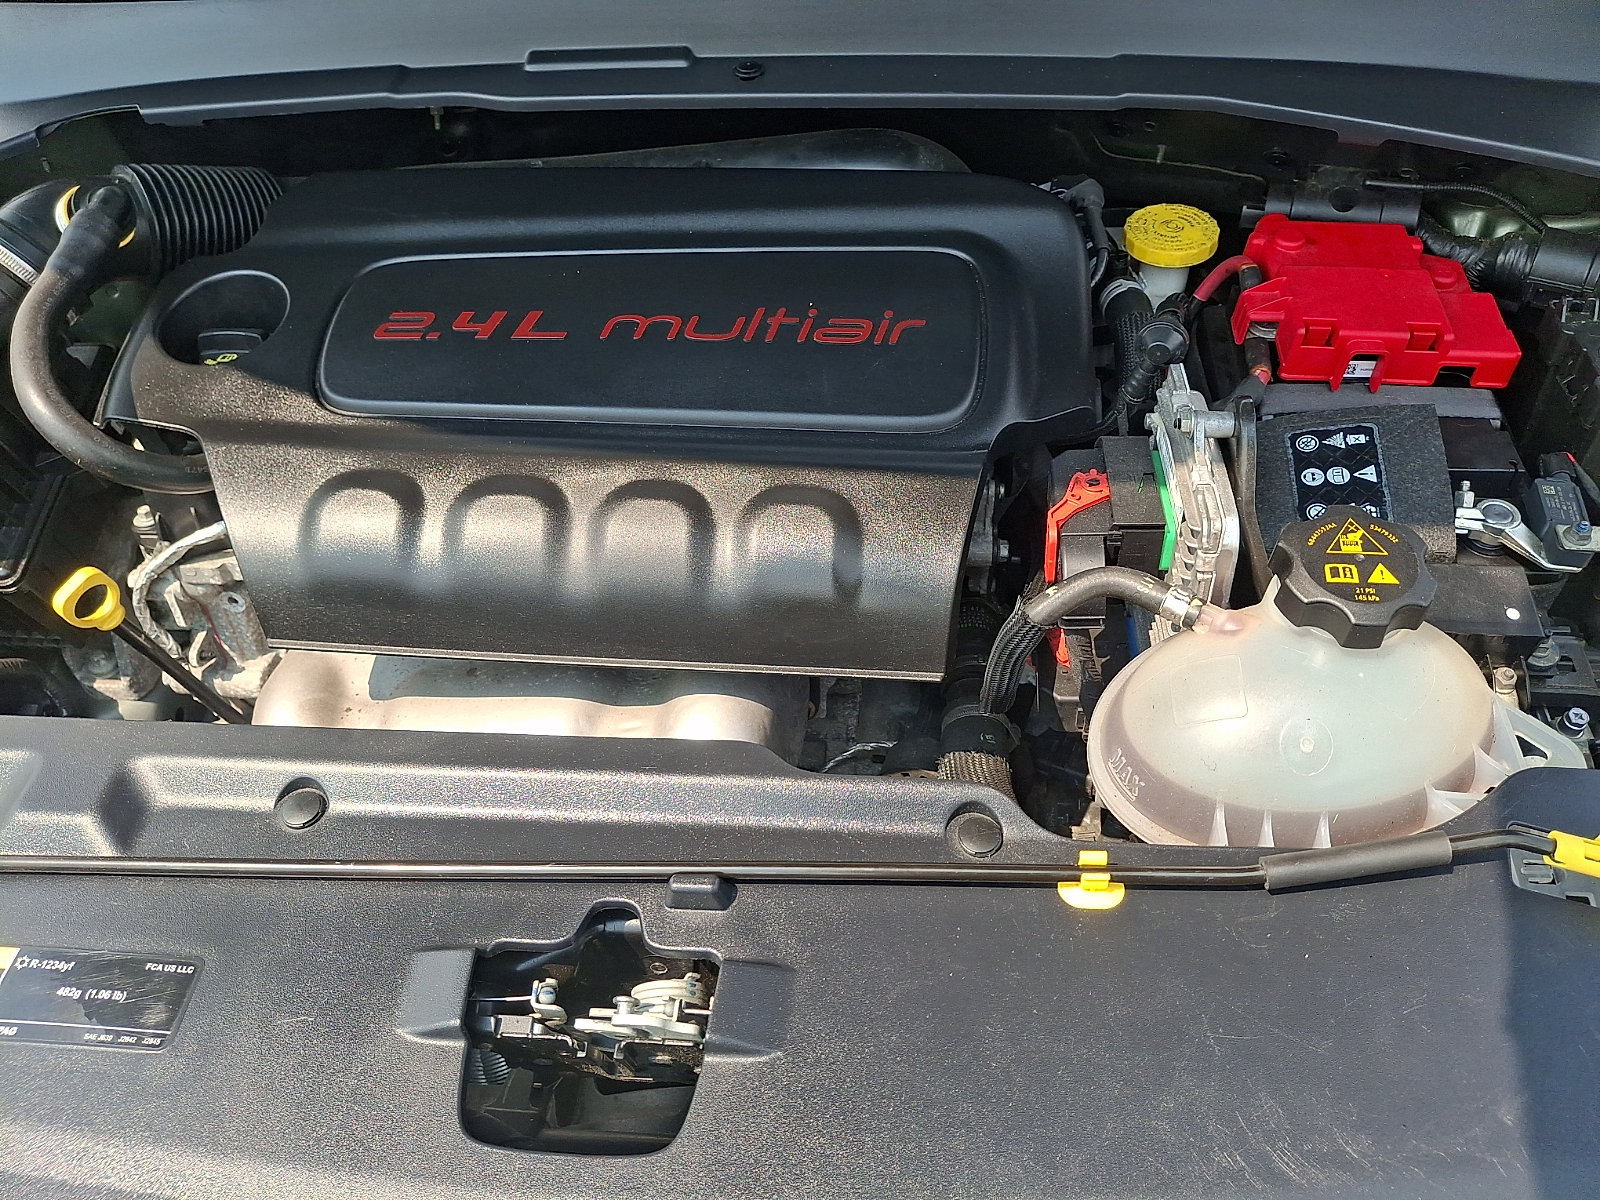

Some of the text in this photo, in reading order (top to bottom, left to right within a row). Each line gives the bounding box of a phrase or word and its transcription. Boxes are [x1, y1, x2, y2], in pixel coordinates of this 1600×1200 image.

[373, 306, 927, 345] 2.4L multiair
[29, 958, 76, 972] R-1234yf
[145, 962, 195, 974] FCA US LLC
[85, 988, 112, 1001] (1.06
